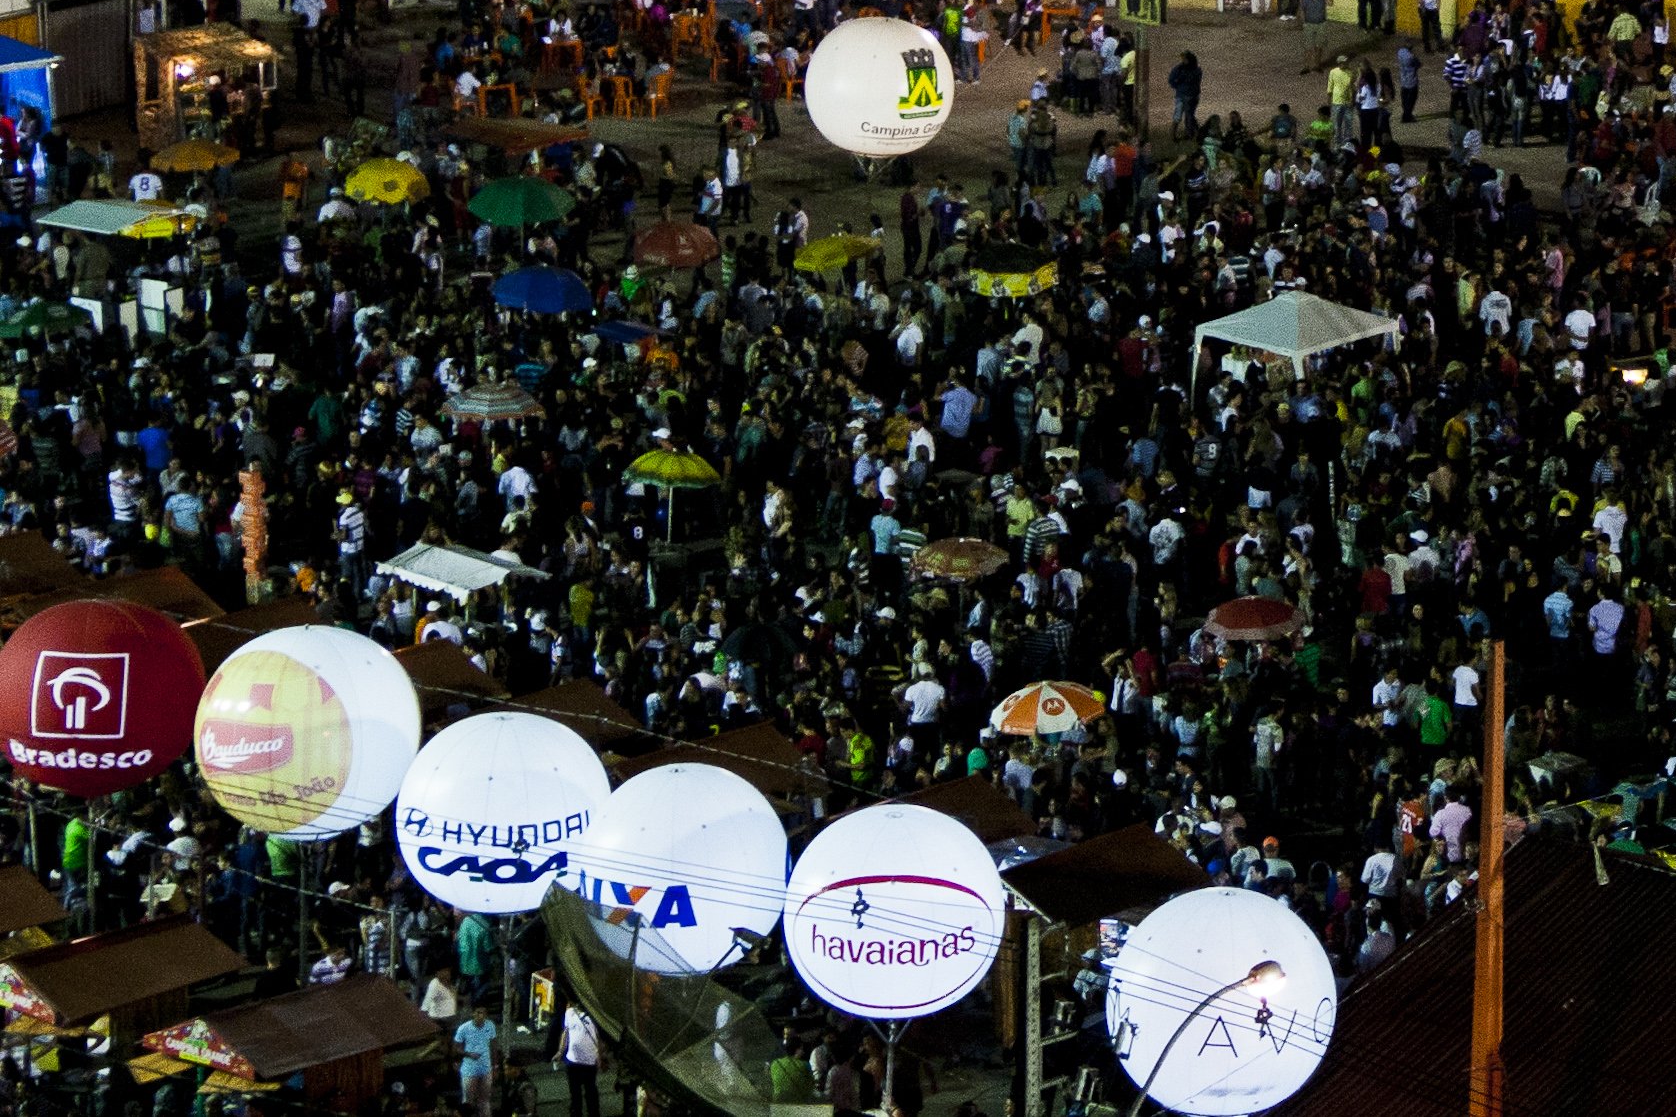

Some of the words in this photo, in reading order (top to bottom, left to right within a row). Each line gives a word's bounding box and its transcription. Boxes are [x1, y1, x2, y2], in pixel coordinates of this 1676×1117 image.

[861, 122, 919, 137] Campina
[141, 177, 150, 191] 8
[634, 526, 643, 539] 8
[9, 739, 153, 769] Bradesco
[202, 726, 285, 763] Bauducco
[442, 809, 590, 849] HYUNDAI
[418, 846, 568, 884] CAOA
[812, 923, 976, 966] havaianas
